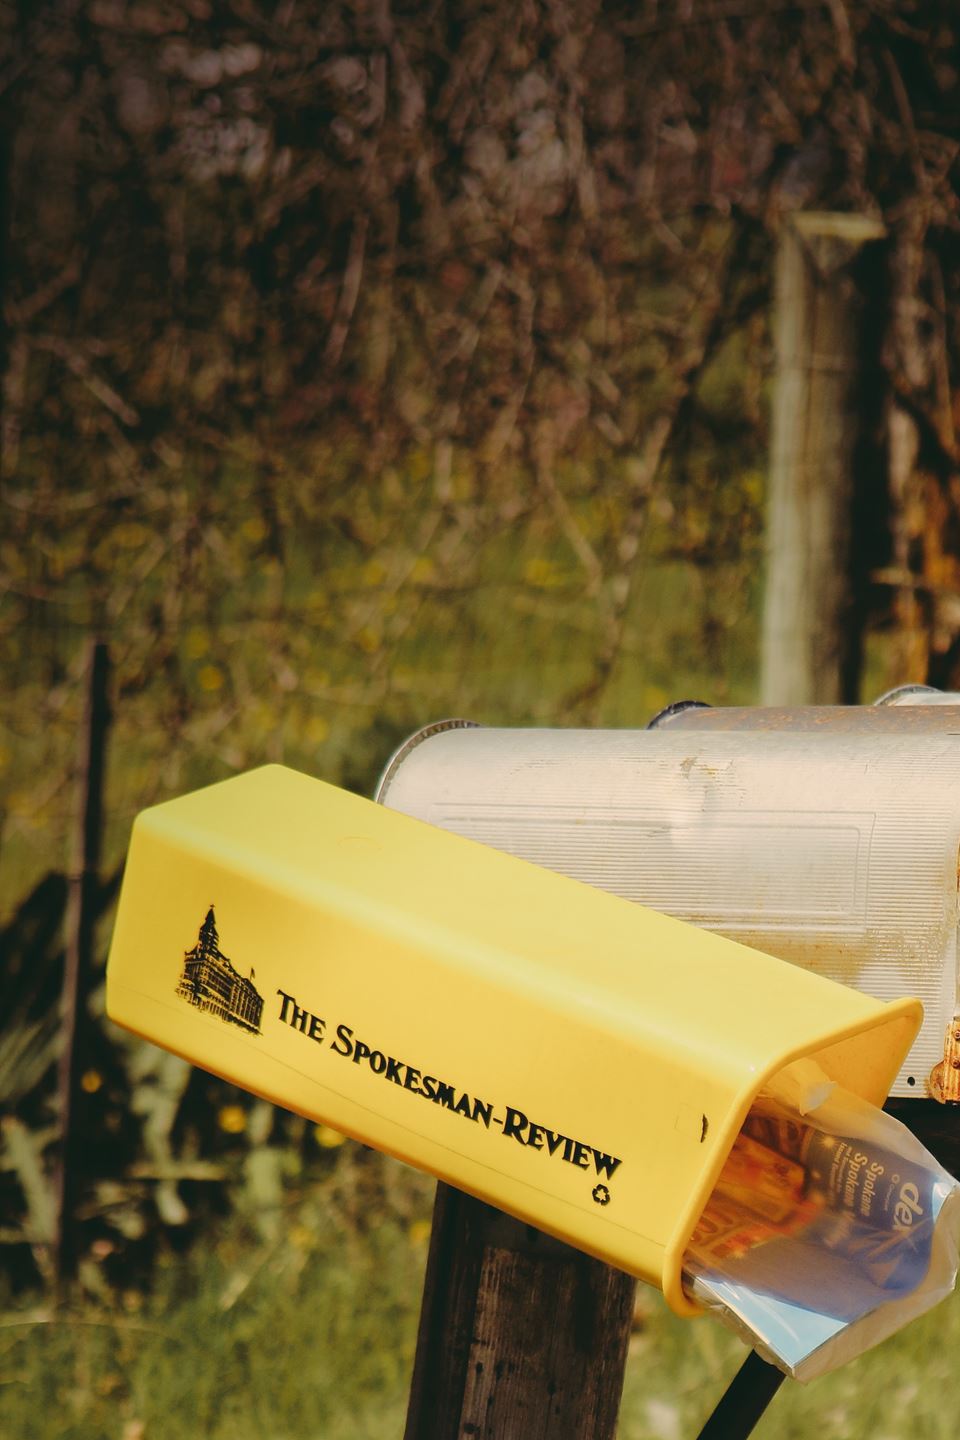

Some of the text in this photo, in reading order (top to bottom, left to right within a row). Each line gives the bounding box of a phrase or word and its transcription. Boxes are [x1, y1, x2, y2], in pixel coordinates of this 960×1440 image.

[276, 989, 623, 1182] THE SPOKESMAN-REVIEW
[861, 1162, 885, 1217] Spokane
